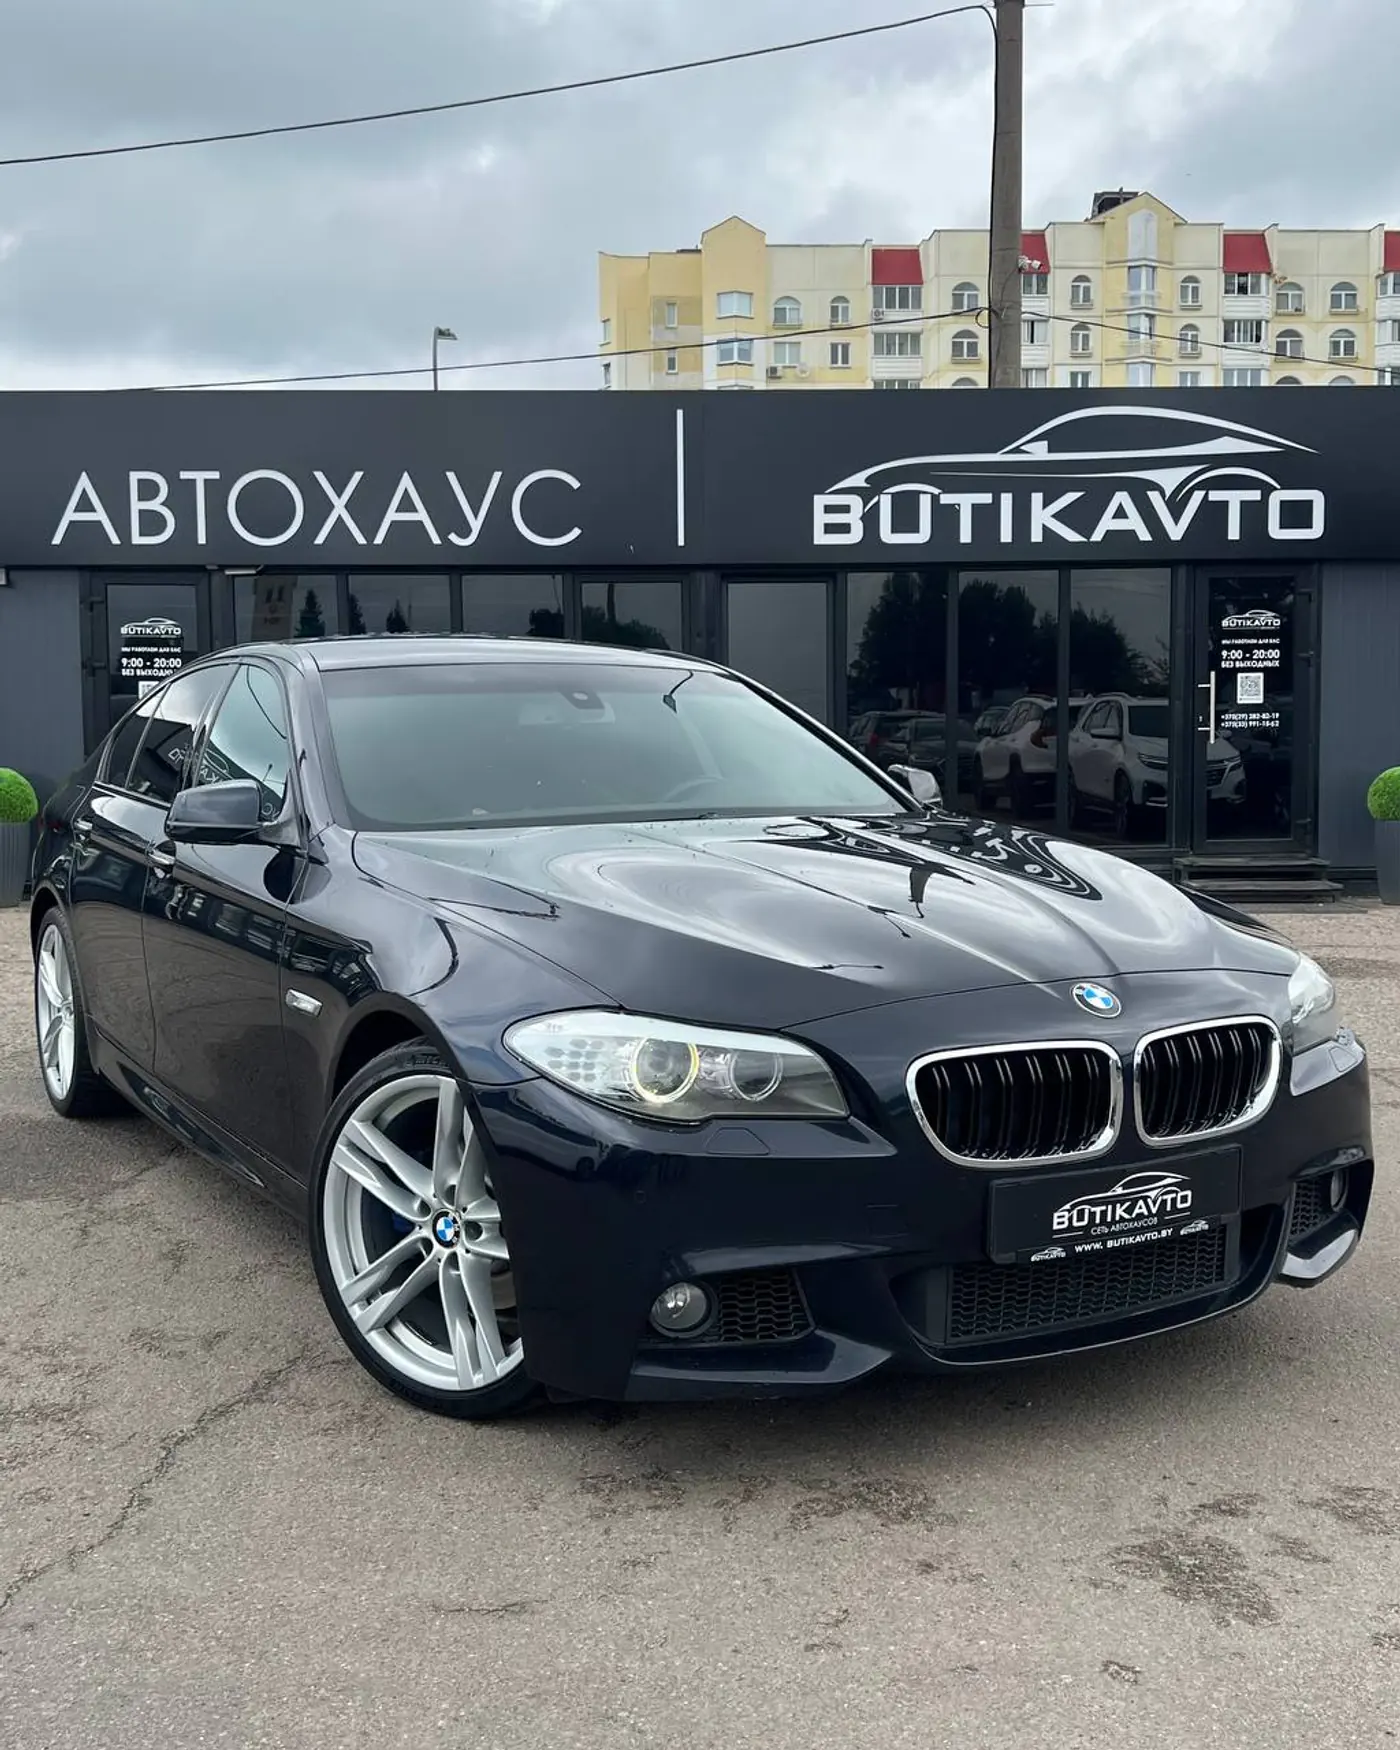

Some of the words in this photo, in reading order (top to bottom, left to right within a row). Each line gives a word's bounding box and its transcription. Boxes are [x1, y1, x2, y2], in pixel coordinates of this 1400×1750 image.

[51, 469, 583, 547] АВТОХАУС
[812, 488, 1326, 546] BUTIKAVTO
[120, 626, 182, 635] BUTIKAVTO
[1221, 618, 1281, 627] BUTIKAVTO
[121, 657, 144, 668] 9:00
[153, 657, 182, 668] 20:00
[1221, 649, 1243, 659] 9:00
[1252, 649, 1280, 659] 20:00
[1052, 1189, 1192, 1231] BUTIKAVTO
[1074, 1241, 1104, 1253] WWW.
[1106, 1227, 1173, 1248] BUTIKAVTO.BY
